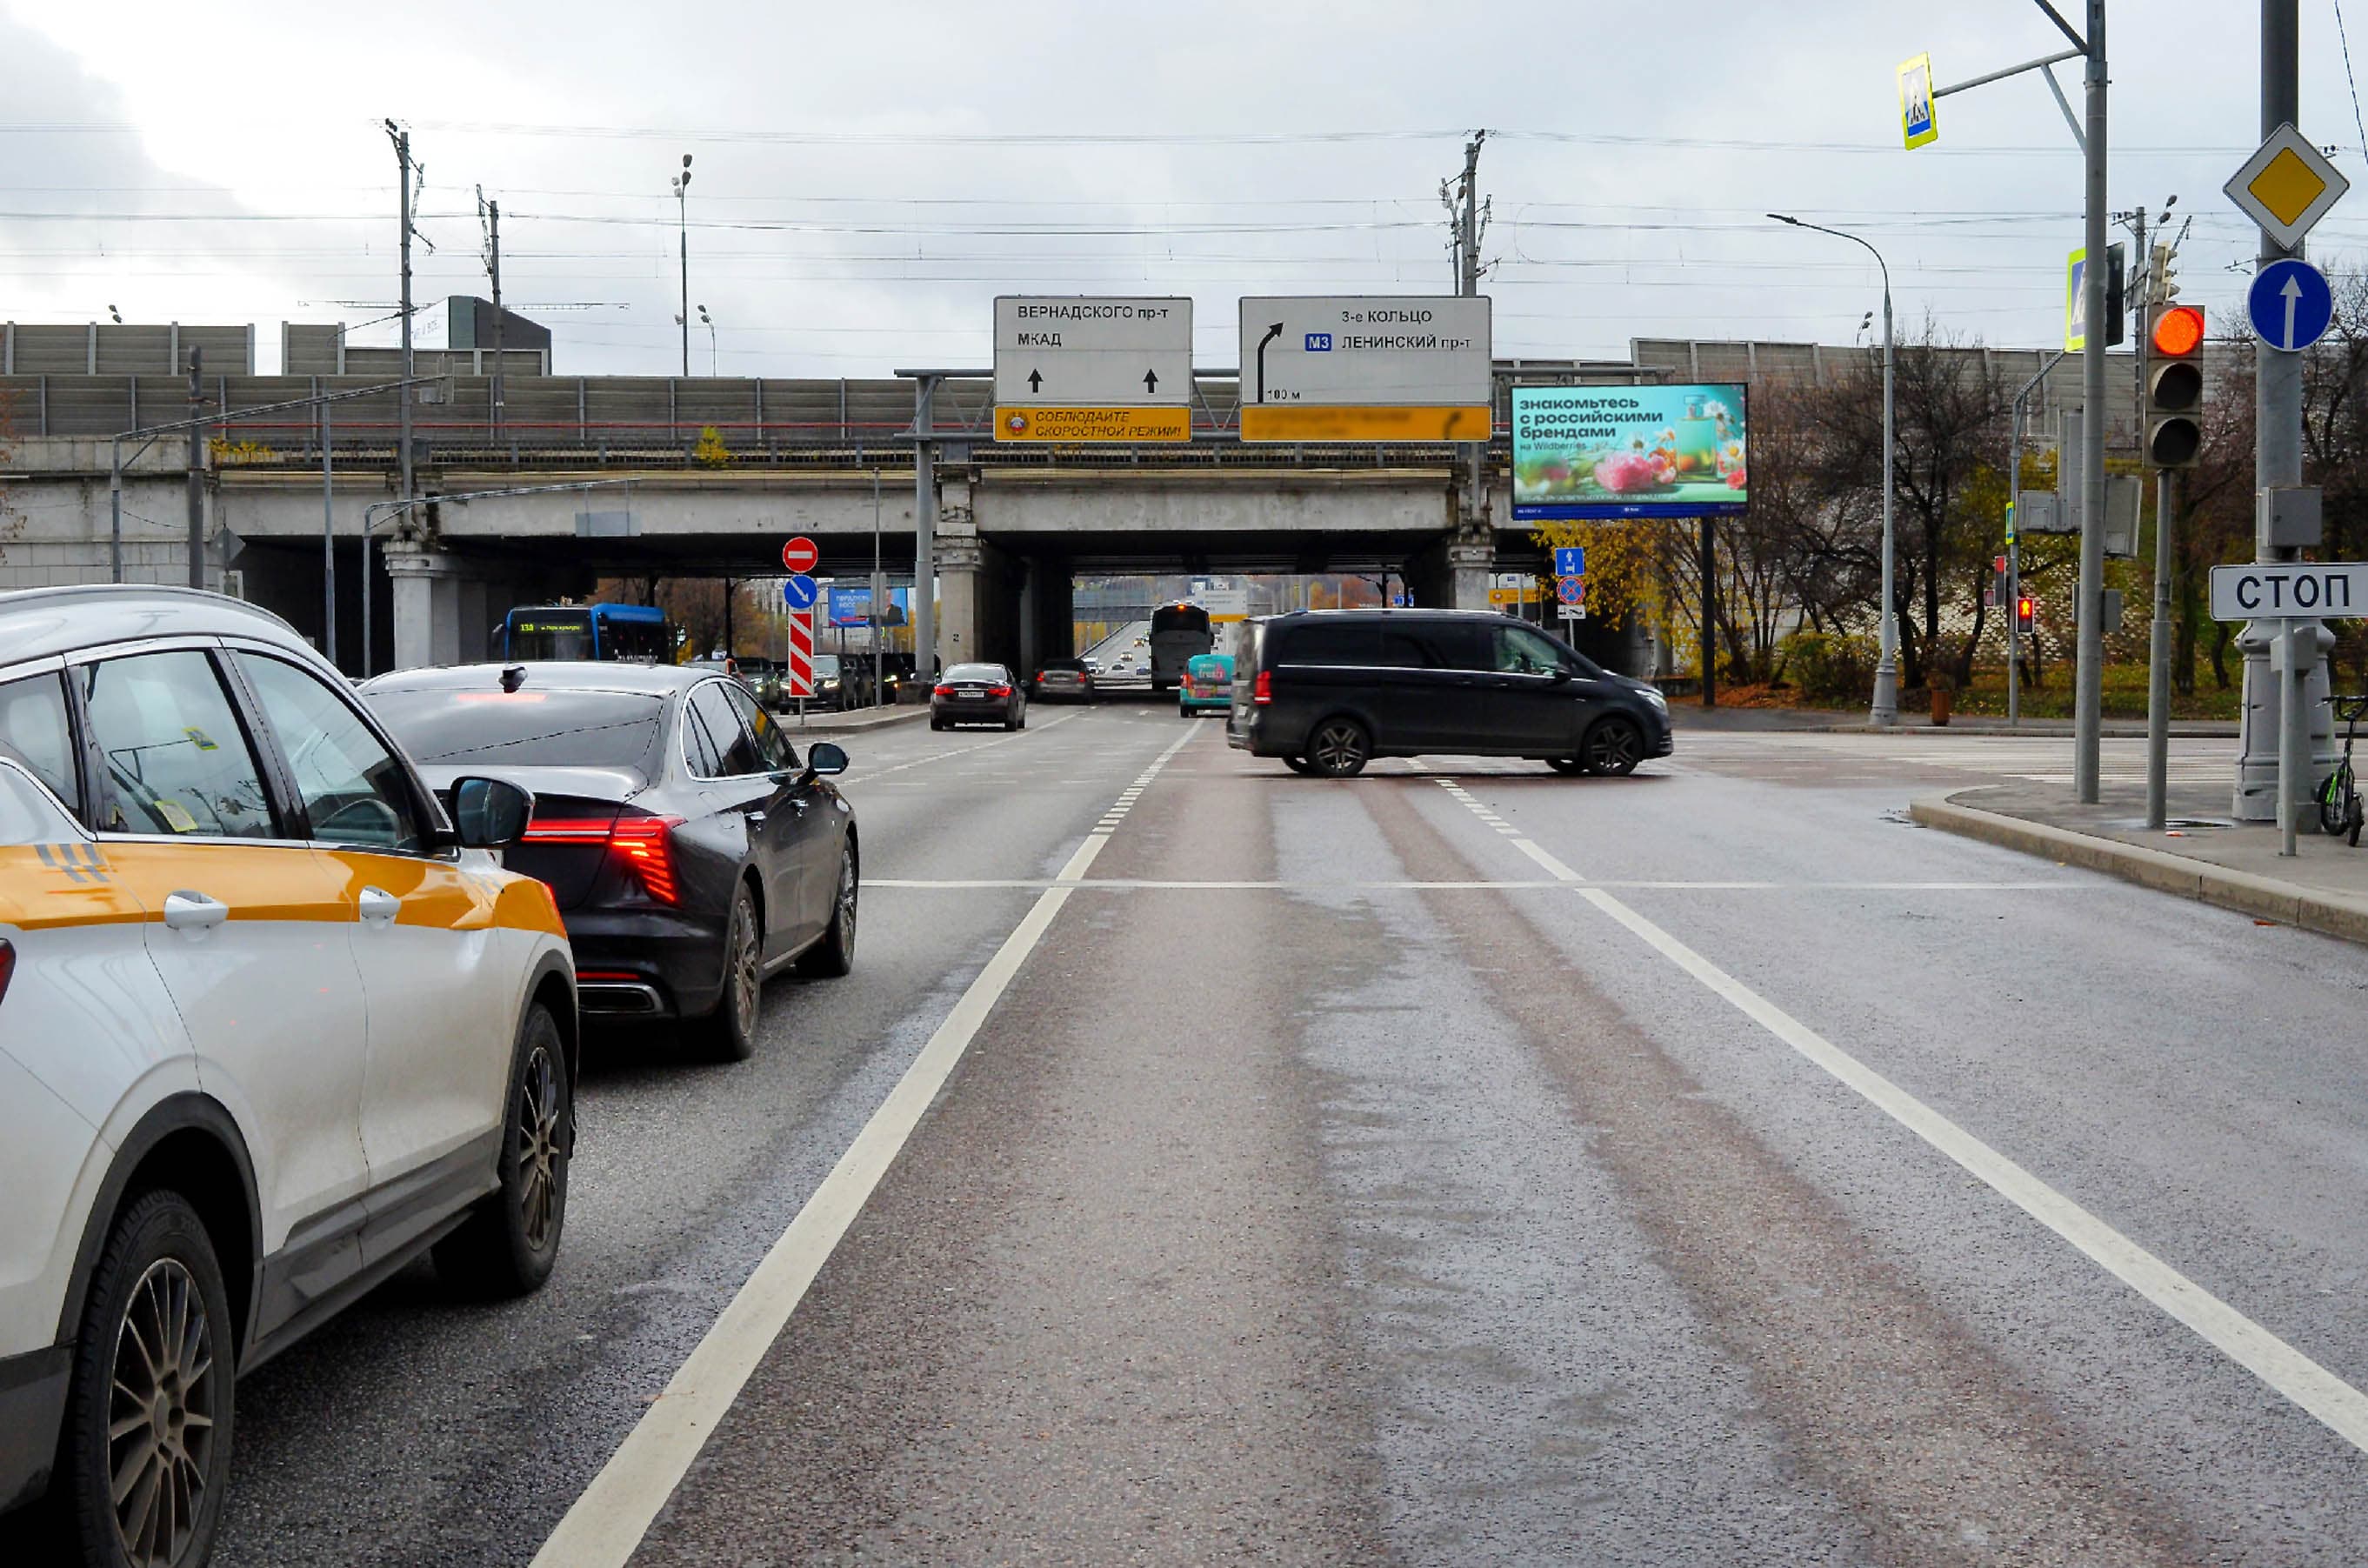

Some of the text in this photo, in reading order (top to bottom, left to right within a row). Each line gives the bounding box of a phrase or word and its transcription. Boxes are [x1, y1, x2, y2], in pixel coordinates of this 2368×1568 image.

[1017, 305, 1169, 321] ВЕРНАДСКОГО пр-т
[1342, 310, 1432, 324] 3-е КОЛЬЦО
[1017, 333, 1062, 347] МКАД
[1308, 334, 1471, 350] М3 ЛЕНИНСКИЙ пр-т
[1519, 397, 1639, 410] знакомьтесь
[1036, 410, 1130, 424] СОБЛЮДАЙТЕ
[1519, 410, 1664, 426] с российскими
[1036, 425, 1181, 437] СКОРОСТНОЙ РЕЖИМ!
[1519, 426, 1617, 440] брендами
[1533, 440, 1587, 450] Wildberries
[2237, 575, 2350, 609] СТОП
